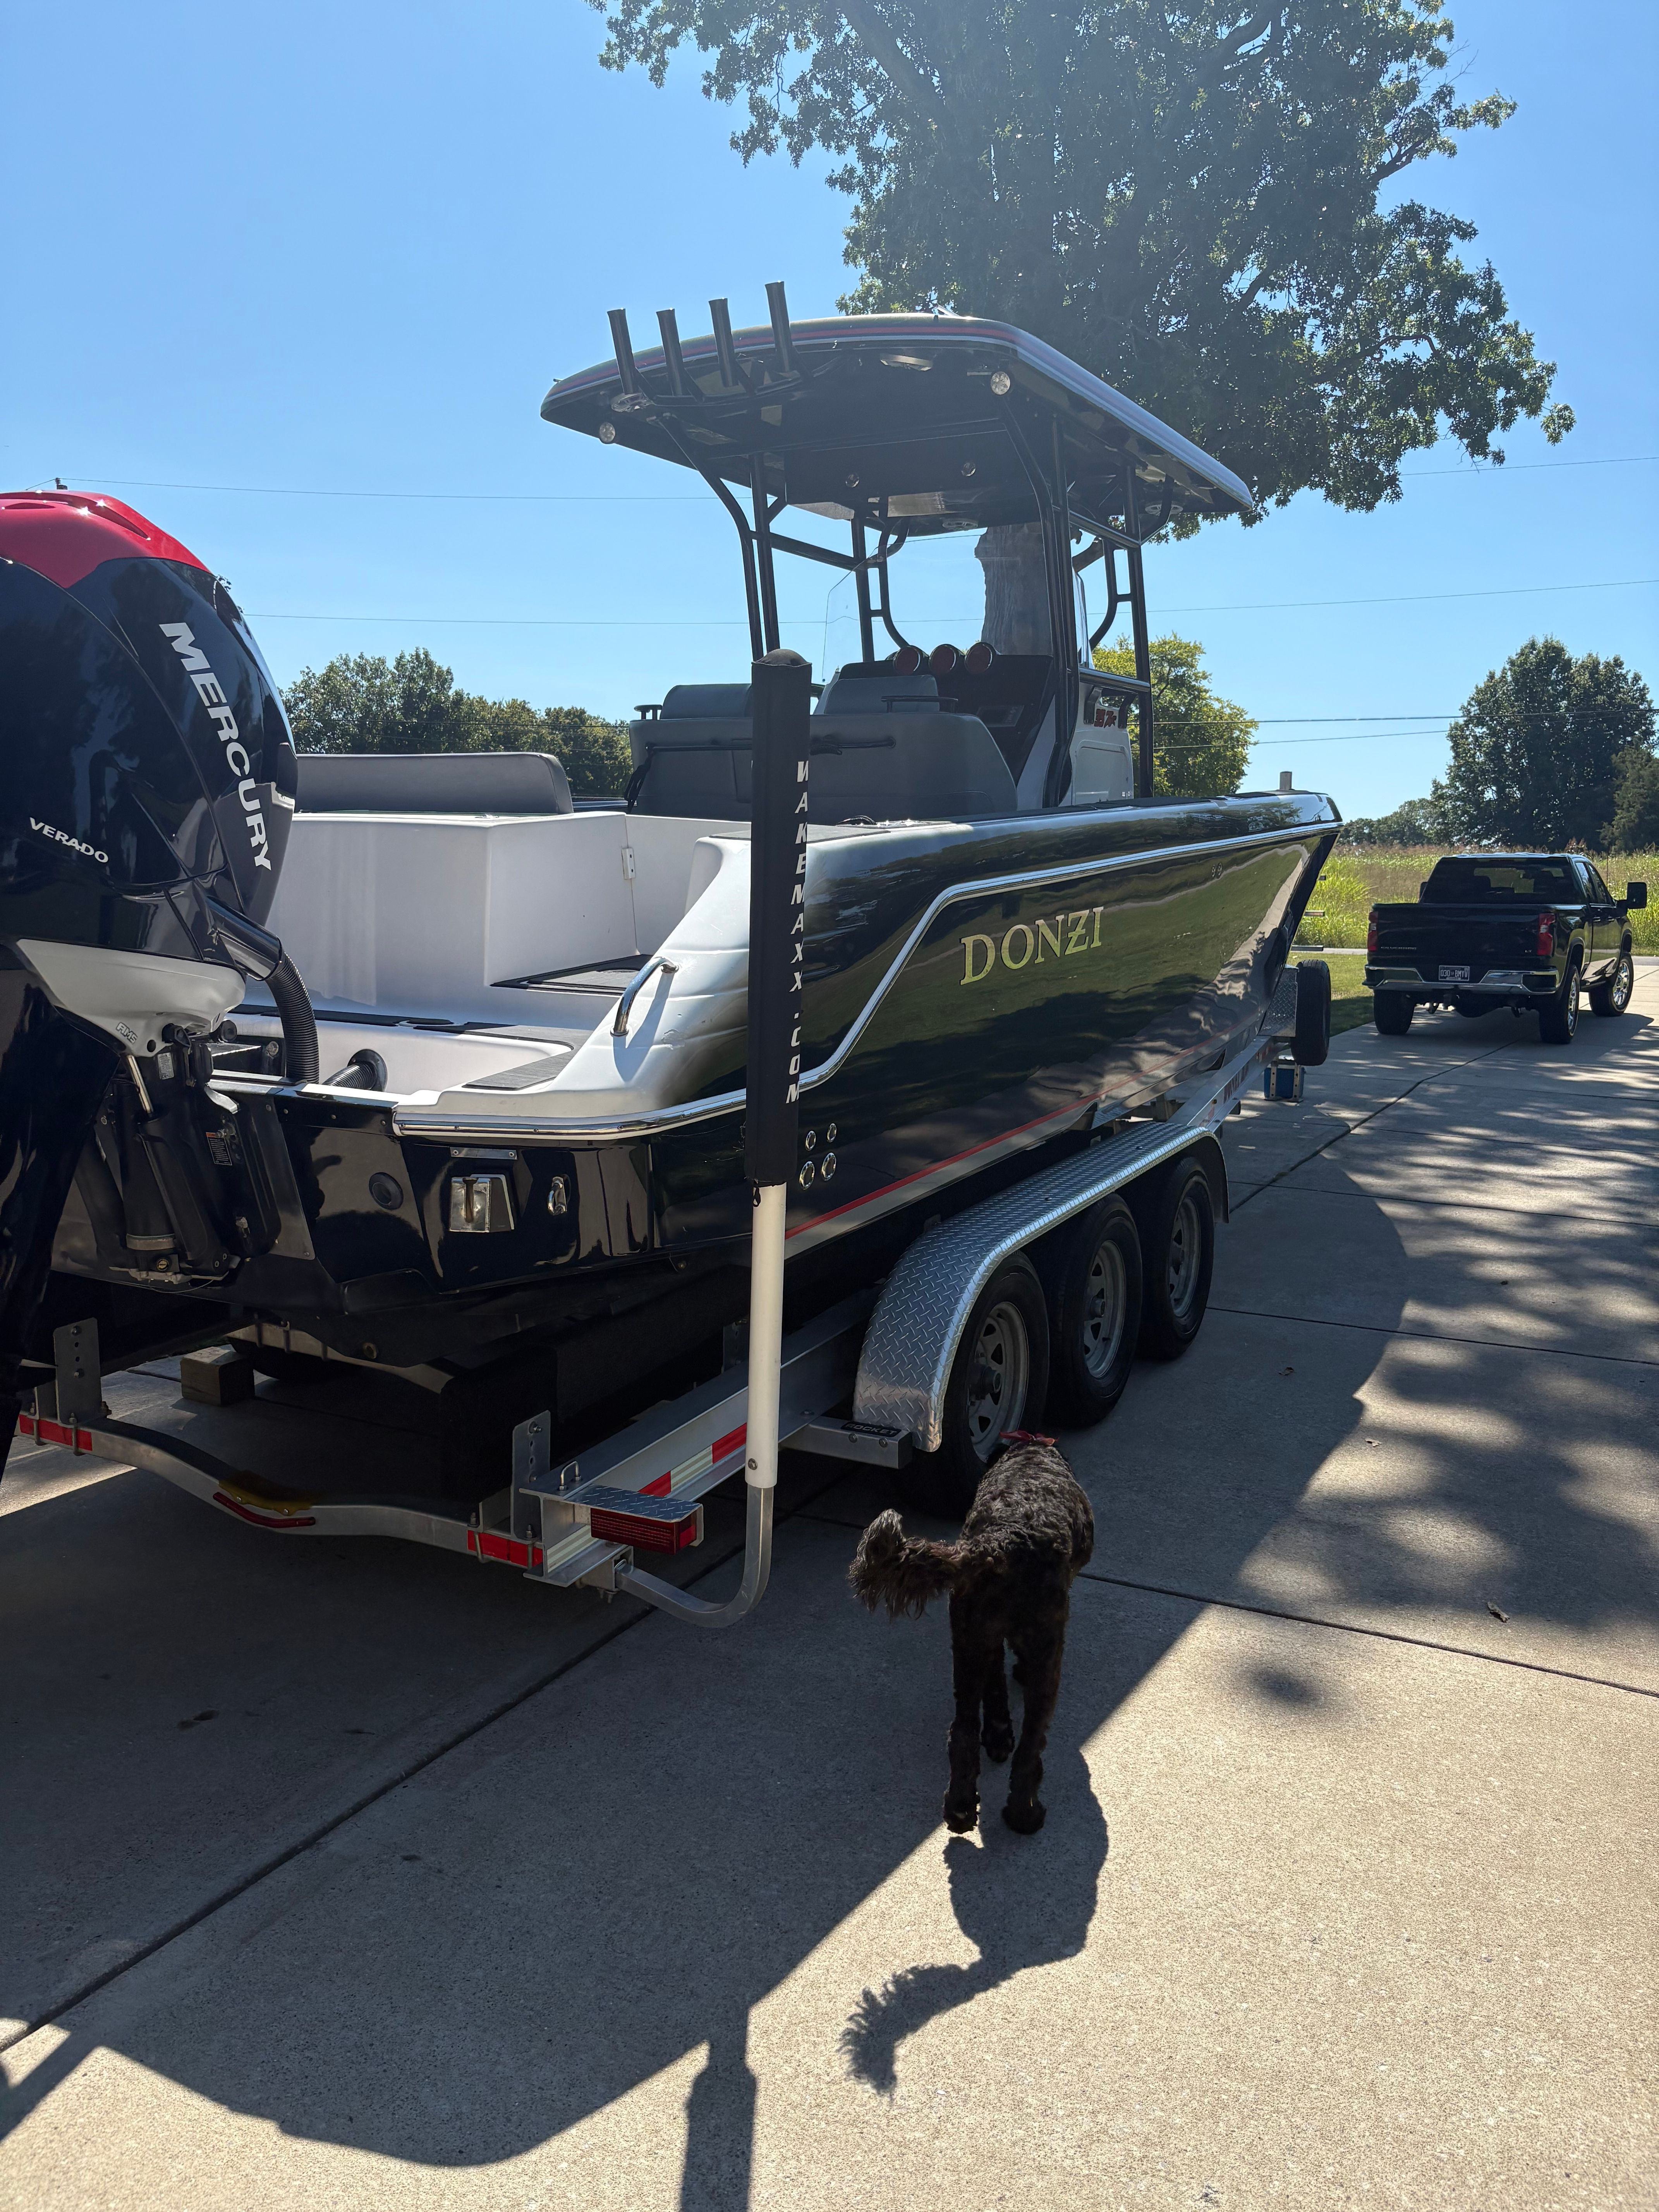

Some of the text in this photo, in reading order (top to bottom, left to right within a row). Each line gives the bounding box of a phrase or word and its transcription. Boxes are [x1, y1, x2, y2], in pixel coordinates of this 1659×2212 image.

[159, 622, 271, 871] MERCURY
[30, 817, 108, 863] VERADO
[960, 907, 1104, 985] DONZI
[116, 1022, 138, 1044] AMS
[845, 1424, 897, 1434] ROCKET
